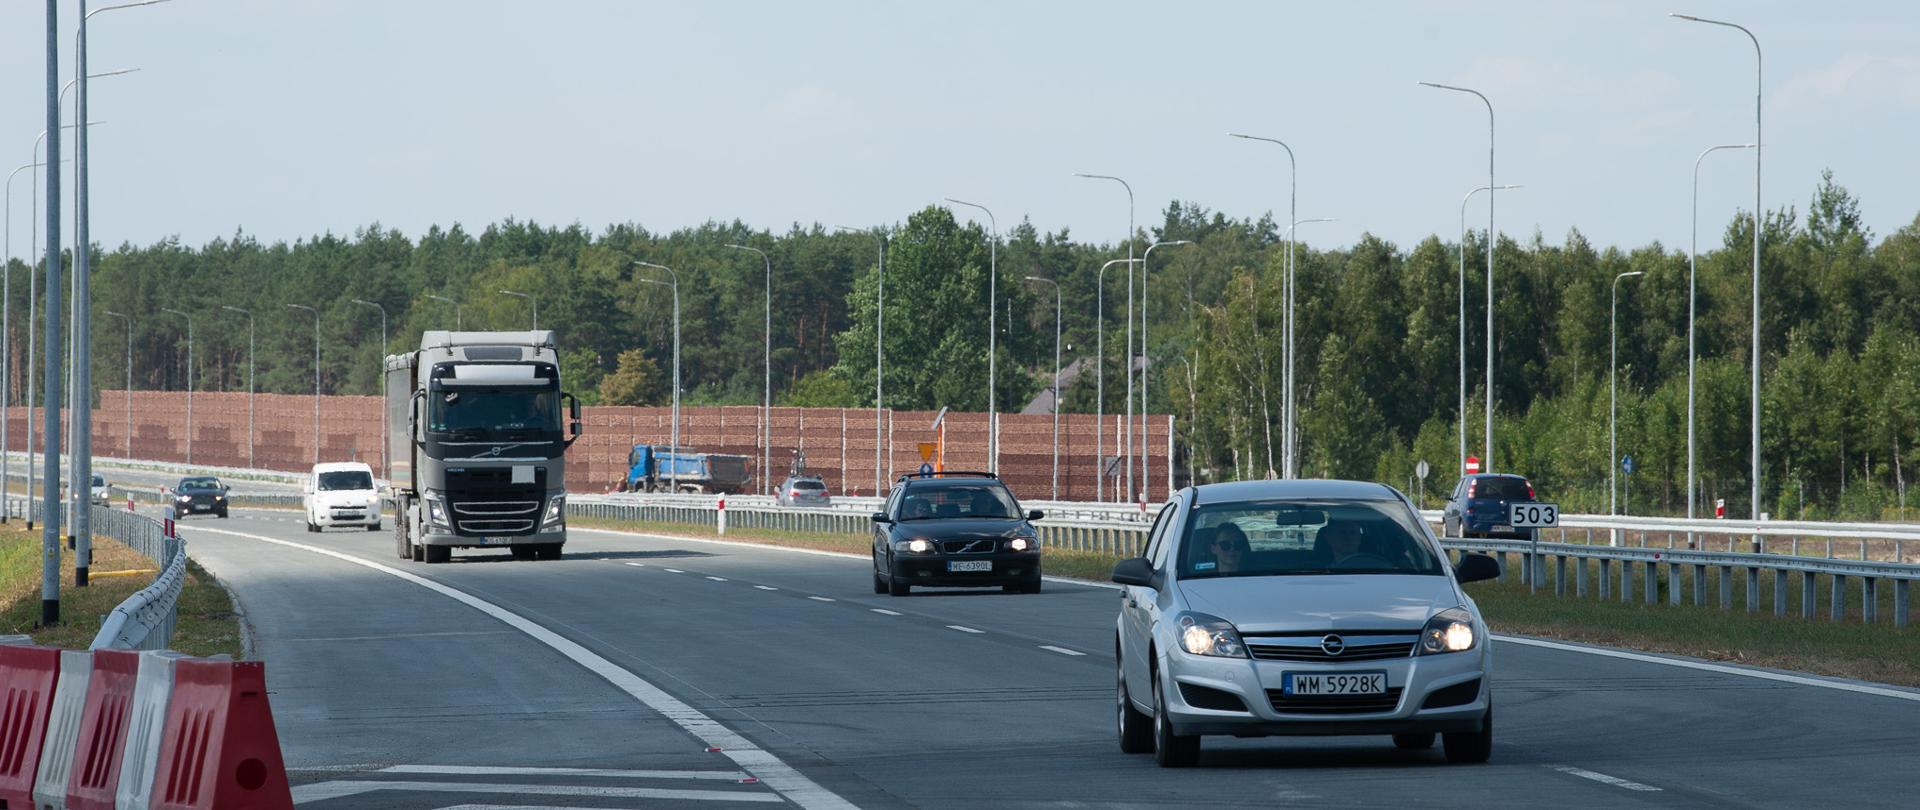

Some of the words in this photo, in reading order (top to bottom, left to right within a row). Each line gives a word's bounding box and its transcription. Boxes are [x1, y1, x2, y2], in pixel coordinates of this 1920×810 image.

[1514, 506, 1555, 524] 503
[1296, 676, 1320, 693] WM
[1326, 675, 1381, 693] 5928K
